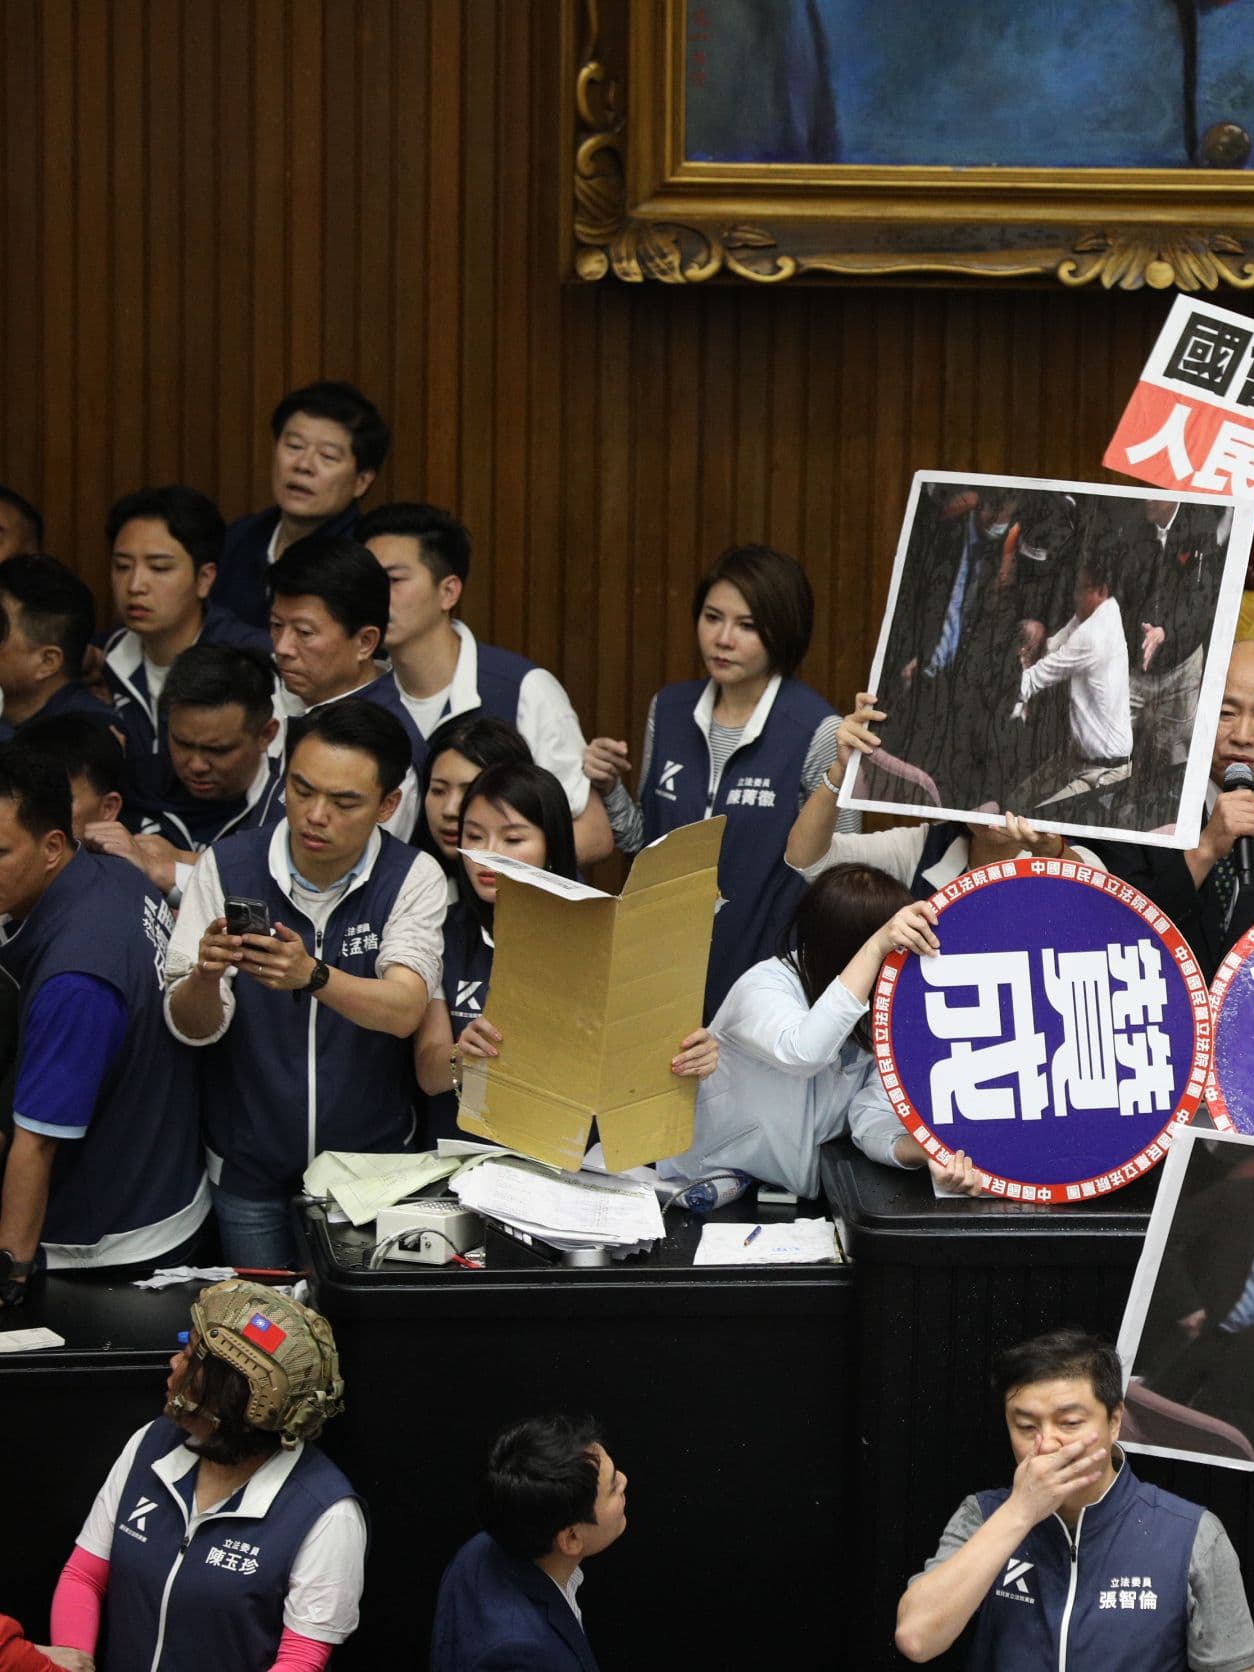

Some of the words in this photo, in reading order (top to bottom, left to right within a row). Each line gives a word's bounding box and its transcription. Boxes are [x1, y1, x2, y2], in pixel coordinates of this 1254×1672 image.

[1031, 860, 1171, 935] 中國國民黨立法院黨團
[875, 965, 911, 1117] 中國國民黨立法院黨團
[920, 939, 1175, 1125] 贊成
[1174, 945, 1210, 1099] 中國國民黨立法院黨團
[205, 1546, 260, 1576] 陳玉珍
[222, 1538, 260, 1556] 立法委員
[1099, 1590, 1158, 1610] 張智倫
[1110, 1577, 1153, 1588] 立法委員
